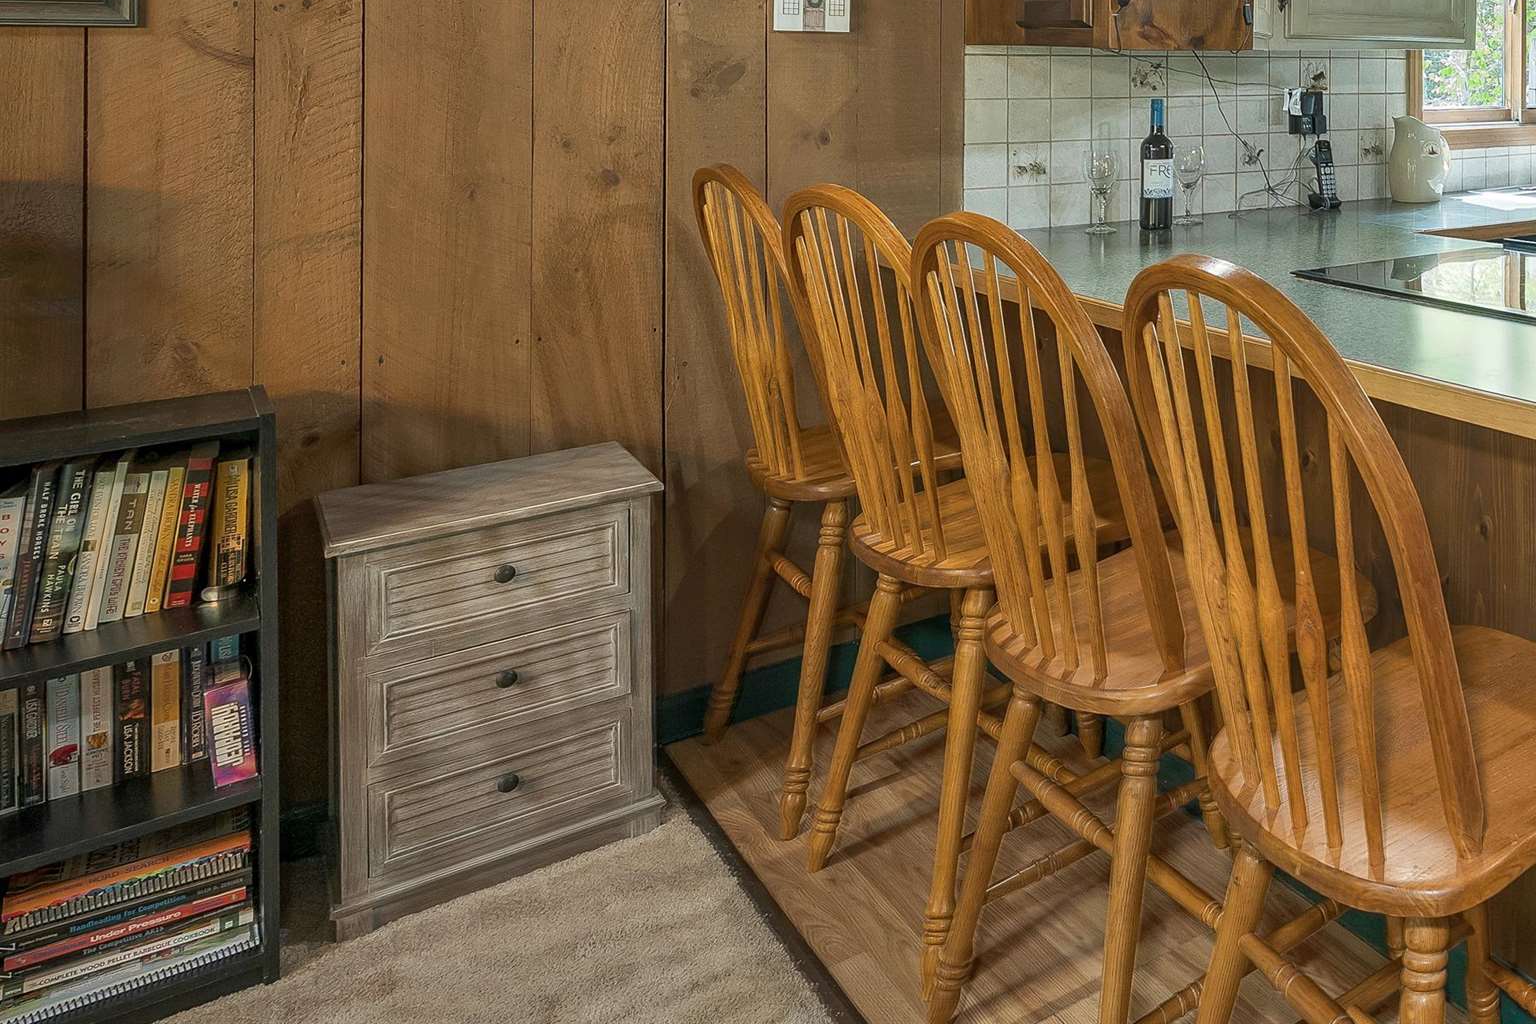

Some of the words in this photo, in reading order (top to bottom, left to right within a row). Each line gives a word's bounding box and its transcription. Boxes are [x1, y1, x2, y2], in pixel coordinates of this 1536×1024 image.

[72, 469, 86, 489] THE
[192, 483, 201, 504] WATER
[37, 503, 48, 528] BROKE
[55, 504, 68, 524] THE
[68, 492, 81, 516] GIRL
[124, 498, 138, 530] TAN
[49, 527, 64, 560] TRAIN
[185, 512, 198, 547] ELEPHANTS
[33, 531, 44, 560] HORSES
[53, 564, 67, 592] PAULA
[41, 574, 55, 613] HAWKINS
[210, 701, 244, 767] JEOPARDY!
[123, 740, 133, 774] JACKSON
[123, 908, 137, 919] for
[138, 894, 187, 915] Competition
[90, 927, 127, 943] Under
[128, 911, 182, 932] Pressure
[39, 969, 78, 986] COMPLETE
[80, 961, 105, 973] WOOD
[107, 953, 133, 965] PELLET
[173, 926, 218, 945] COOKBOOK
